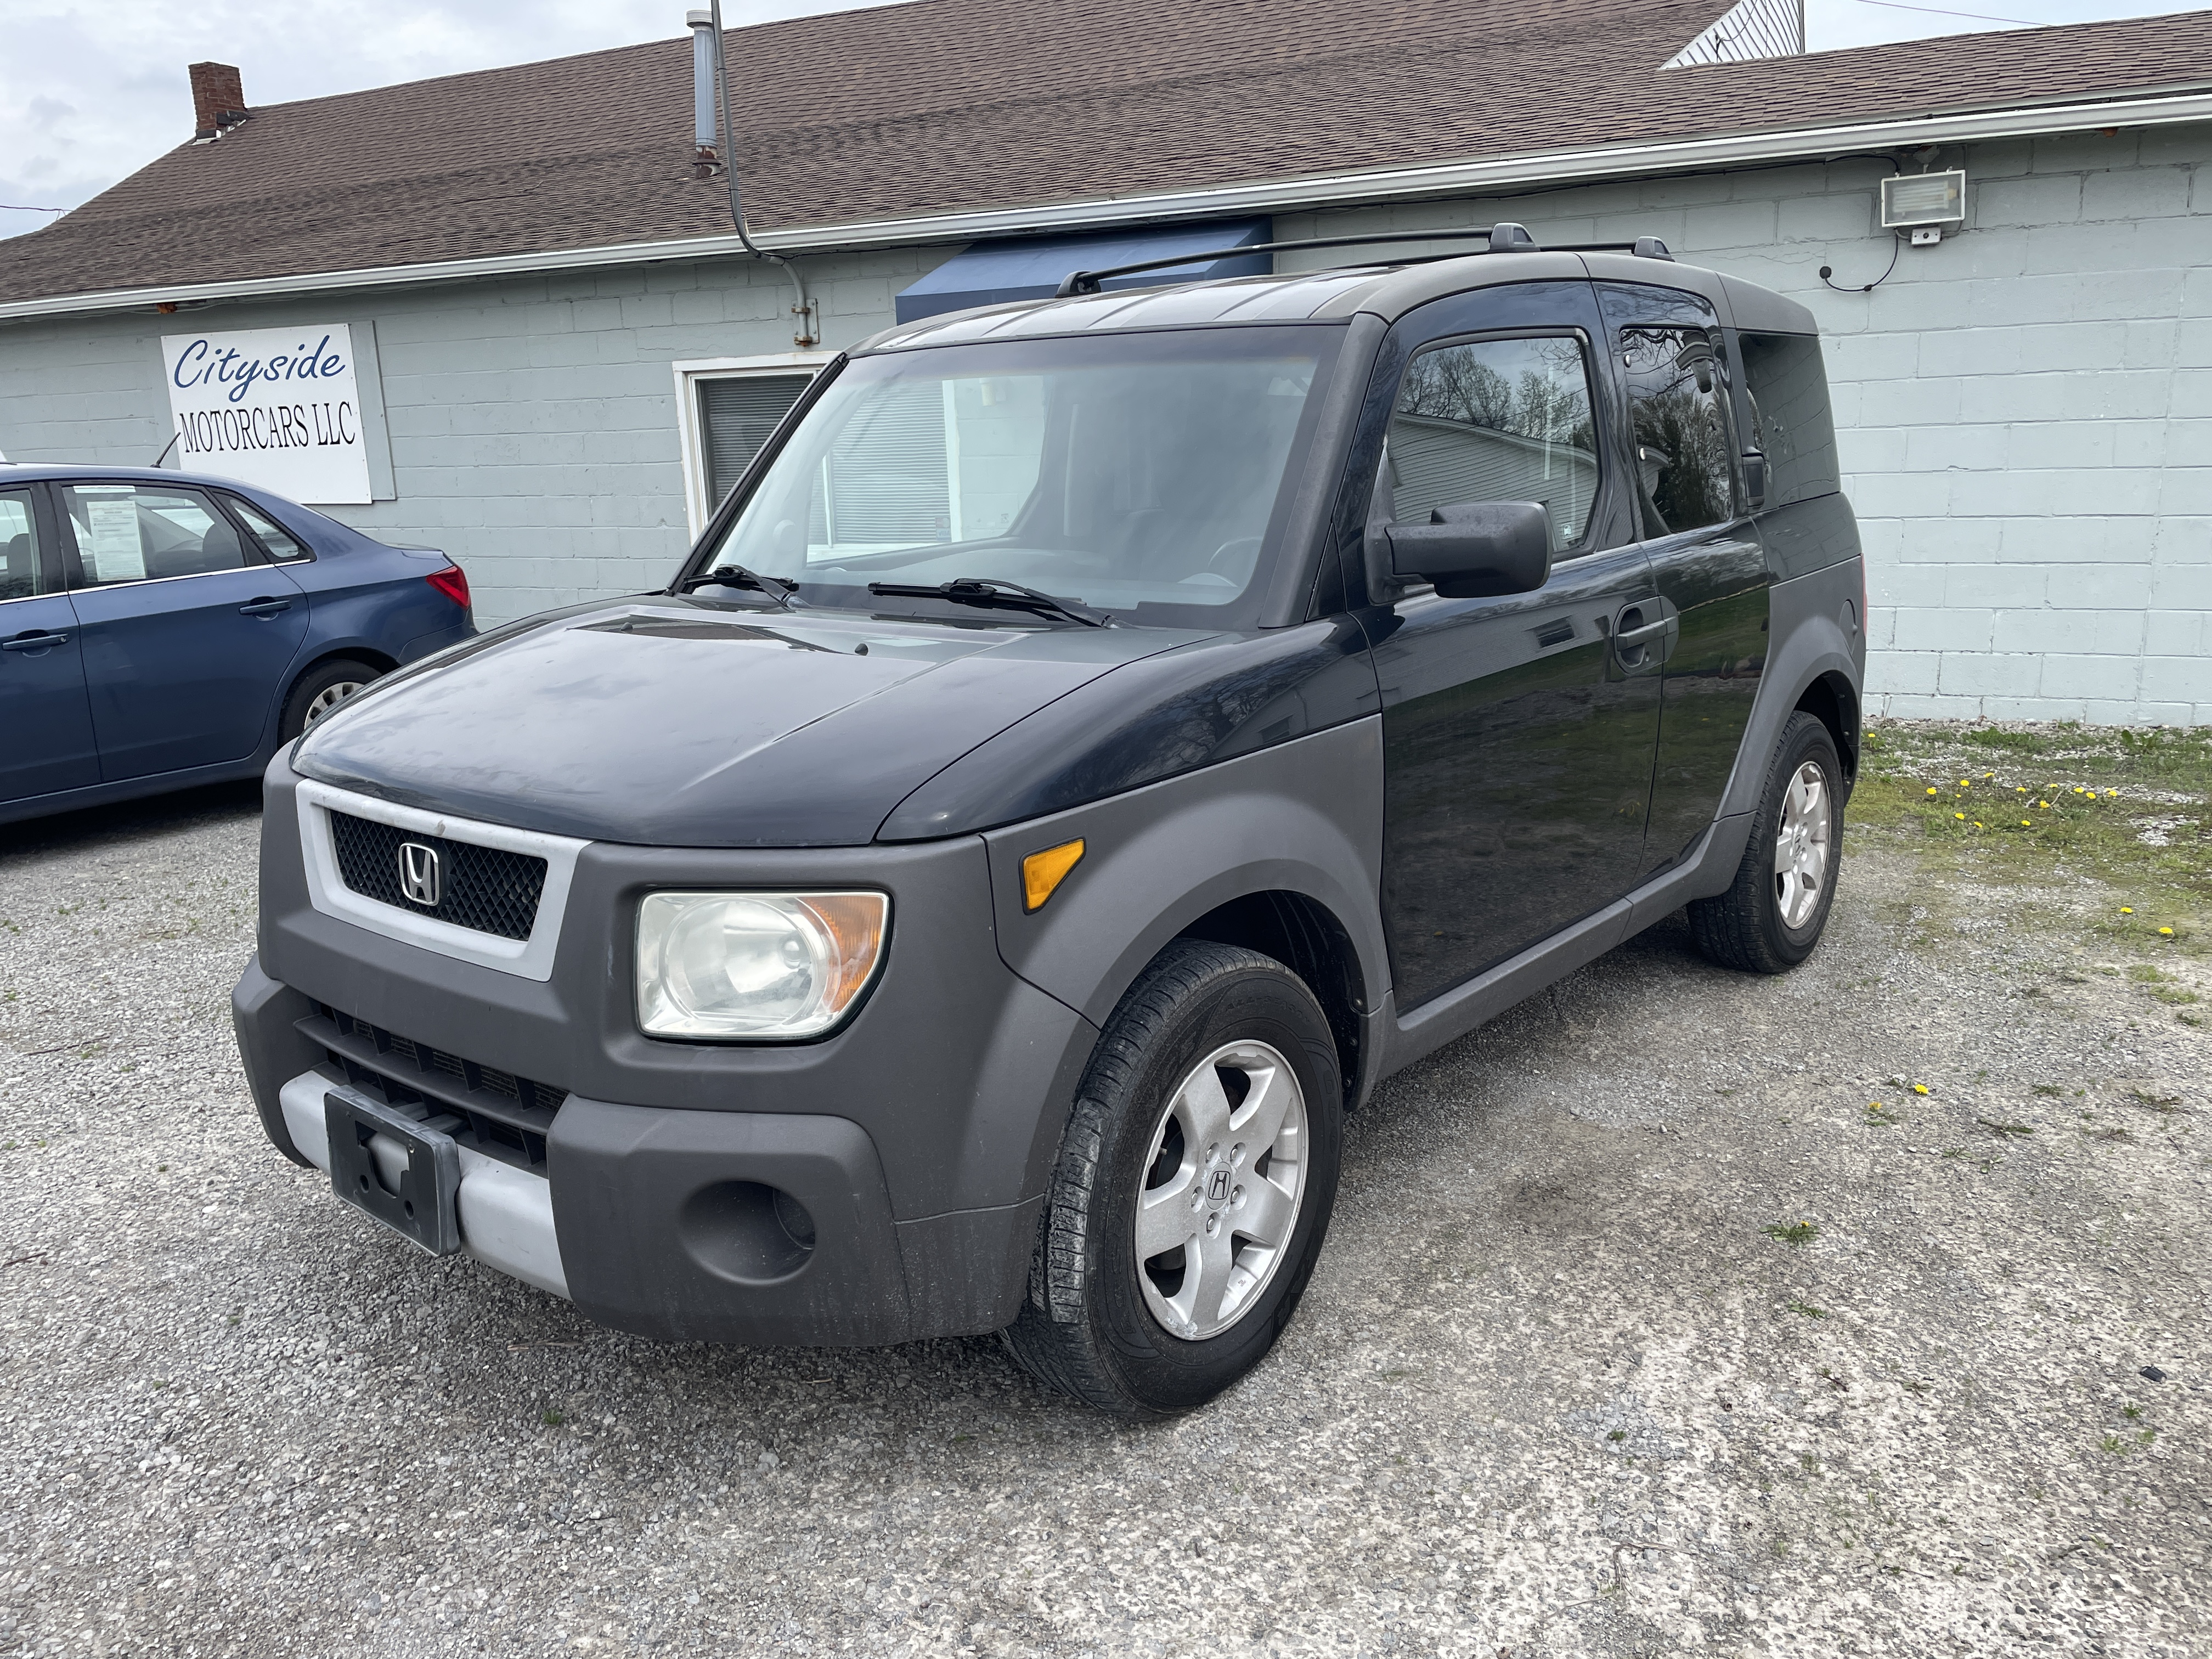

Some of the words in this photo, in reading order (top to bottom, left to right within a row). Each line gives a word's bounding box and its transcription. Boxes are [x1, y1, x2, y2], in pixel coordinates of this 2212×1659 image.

[174, 335, 346, 402] Cityside
[179, 404, 309, 453] MOTORCARS
[311, 401, 356, 445] LLC
